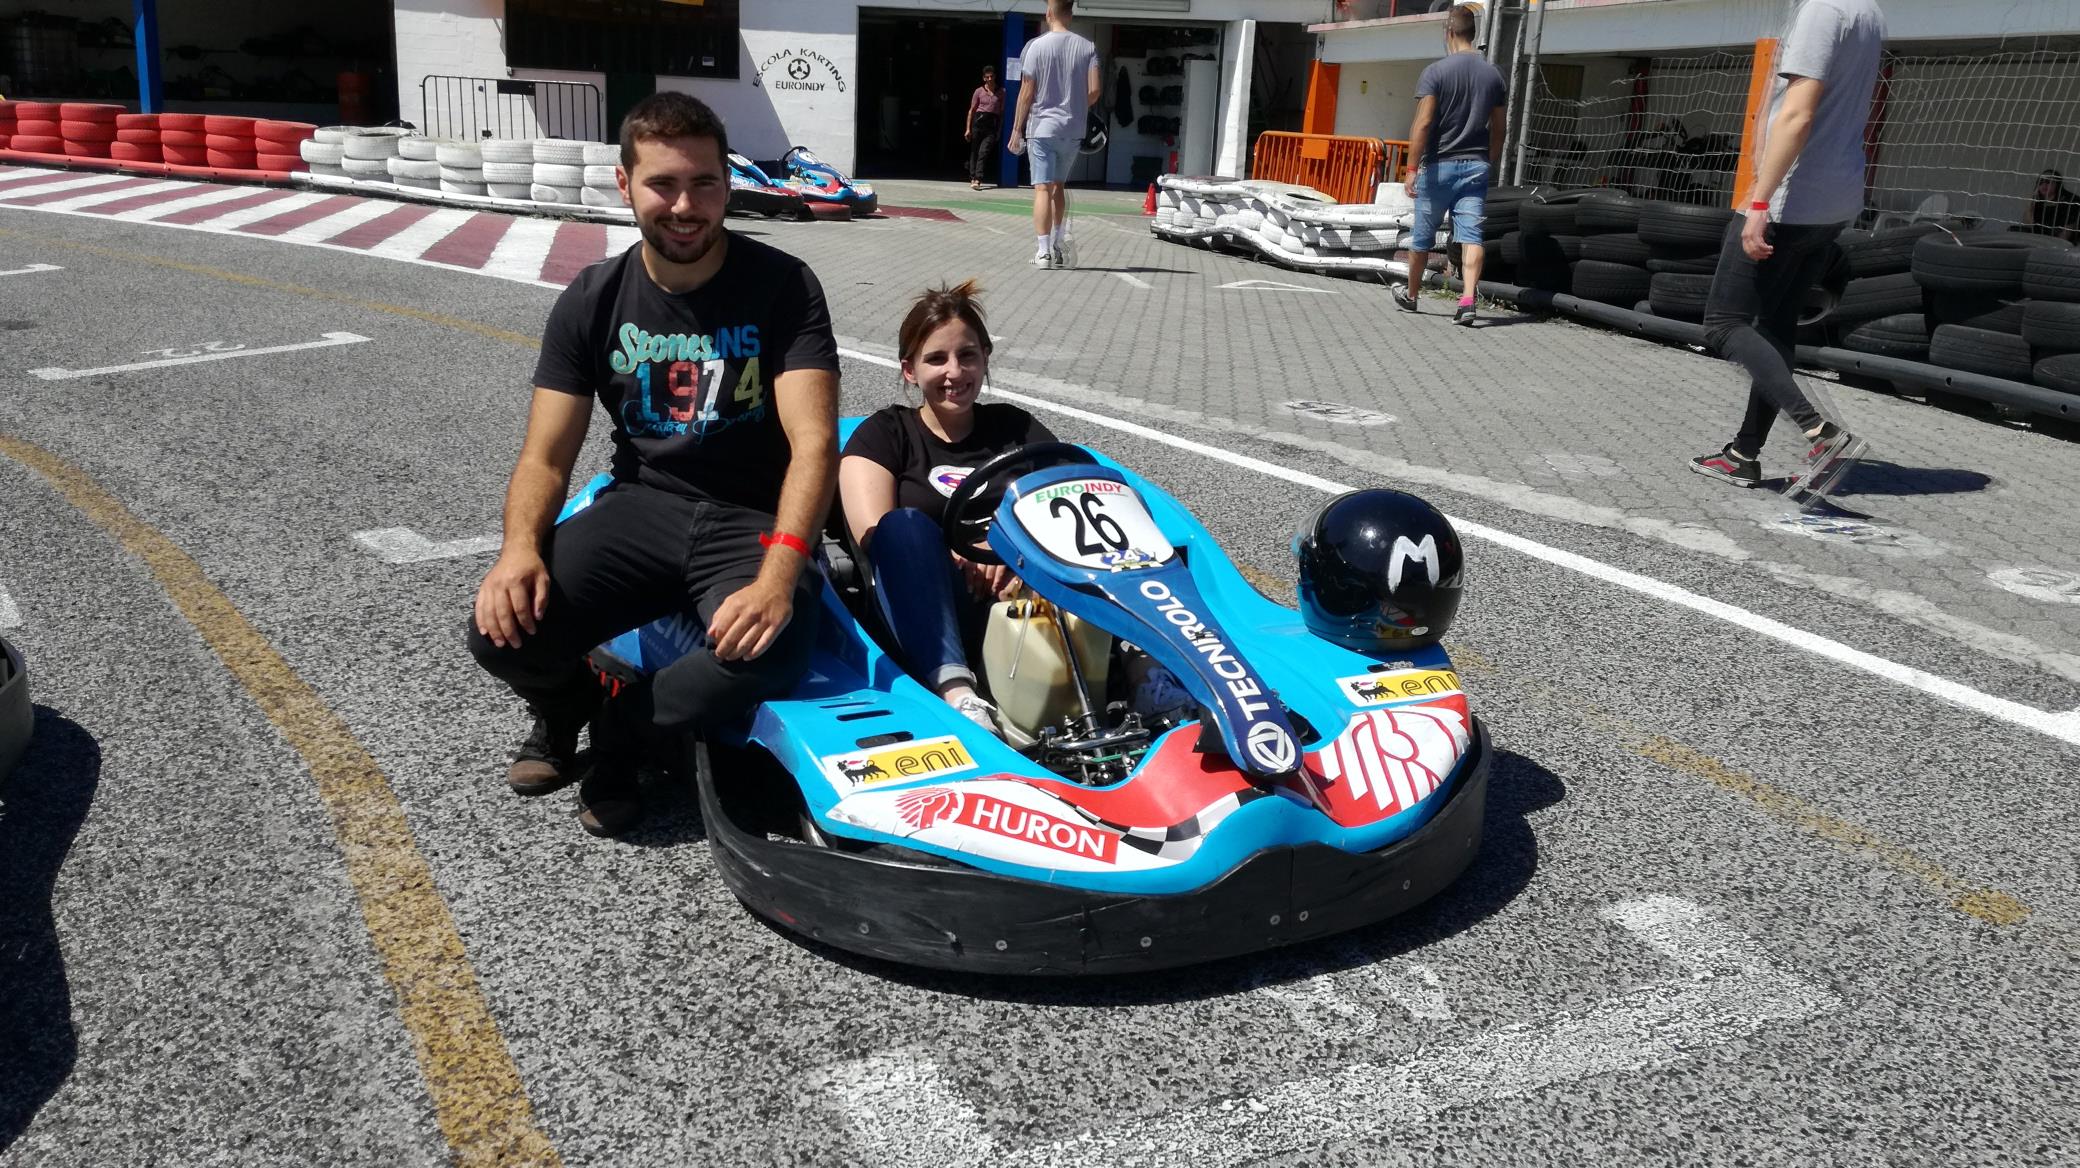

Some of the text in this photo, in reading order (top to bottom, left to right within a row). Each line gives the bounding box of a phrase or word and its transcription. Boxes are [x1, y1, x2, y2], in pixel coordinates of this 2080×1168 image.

[752, 48, 847, 93] ESCOLA KARTING
[775, 80, 826, 92] EUROINDY
[609, 322, 714, 374] Stones
[636, 356, 763, 422] 1974
[1035, 482, 1122, 504] EUROINDY
[1049, 492, 1130, 557] 26
[1388, 534, 1440, 593] M
[1139, 580, 1270, 722] TECNIROLO
[1401, 672, 1461, 697] eni
[895, 747, 966, 777] eni
[973, 798, 1106, 858] HURON
